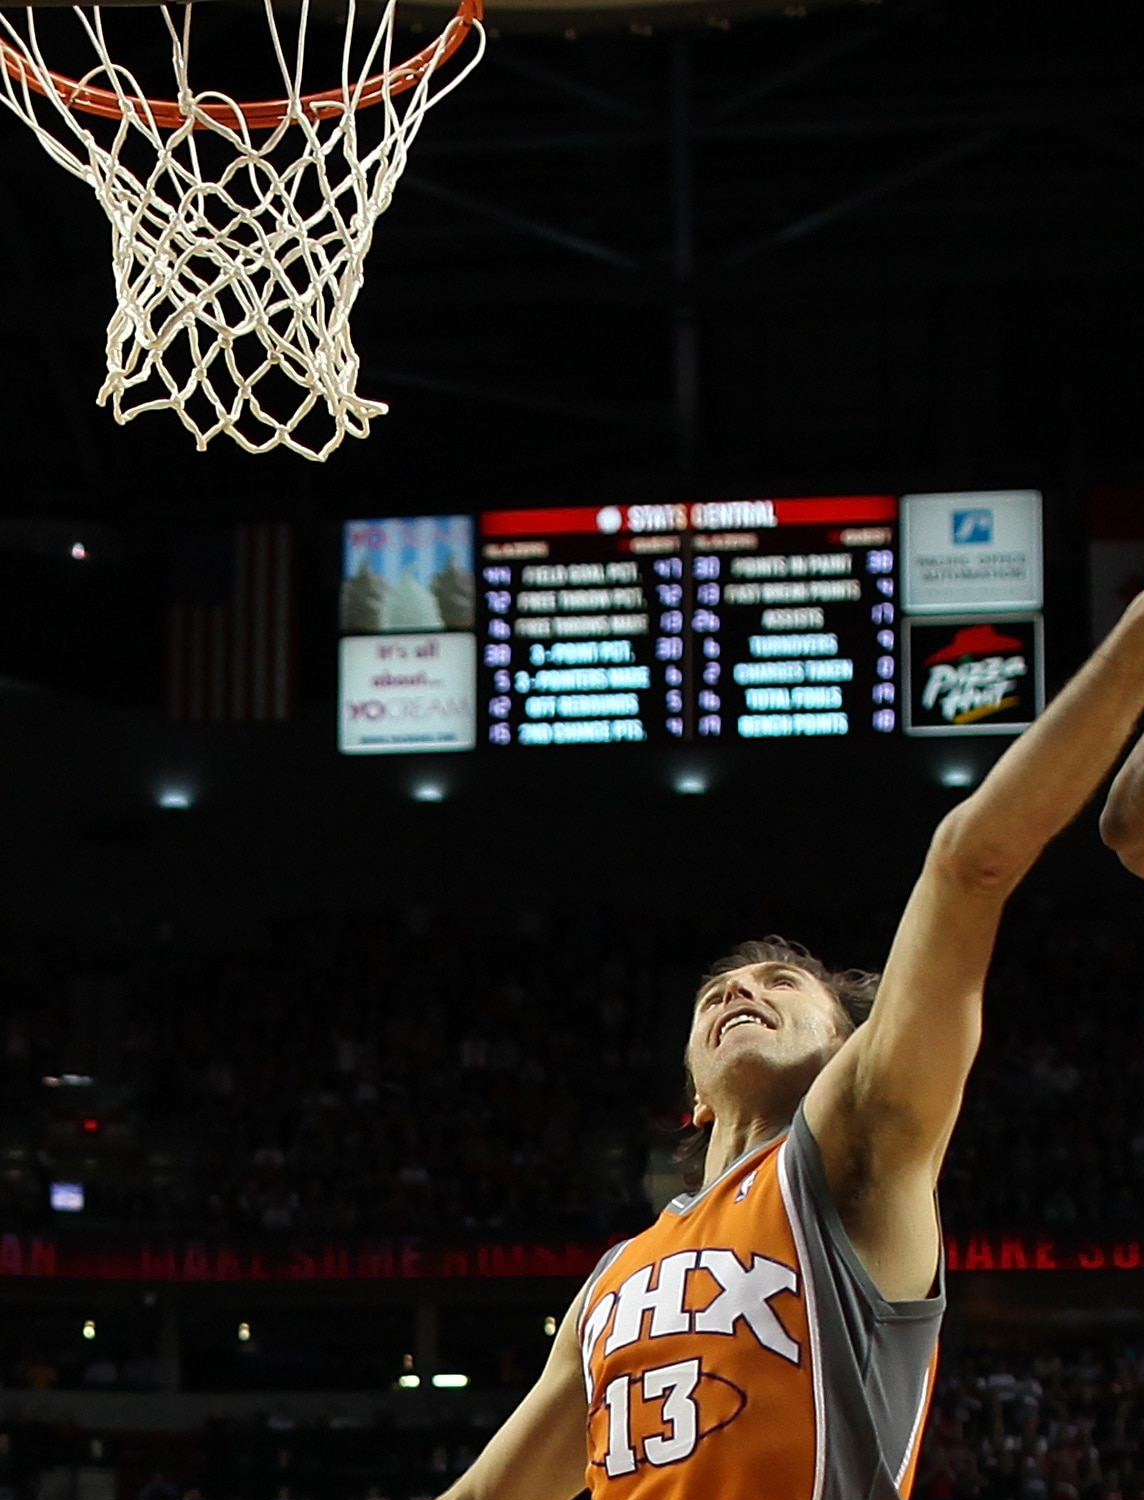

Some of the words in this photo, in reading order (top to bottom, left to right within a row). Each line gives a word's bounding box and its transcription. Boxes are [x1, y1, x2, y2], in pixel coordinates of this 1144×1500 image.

[628, 504, 688, 533] STATS
[691, 501, 778, 528] CENTRAL
[922, 655, 1027, 710] Pizza
[940, 678, 1017, 722] Hut
[581, 1247, 803, 1405] PHX
[604, 1356, 703, 1480] 13
